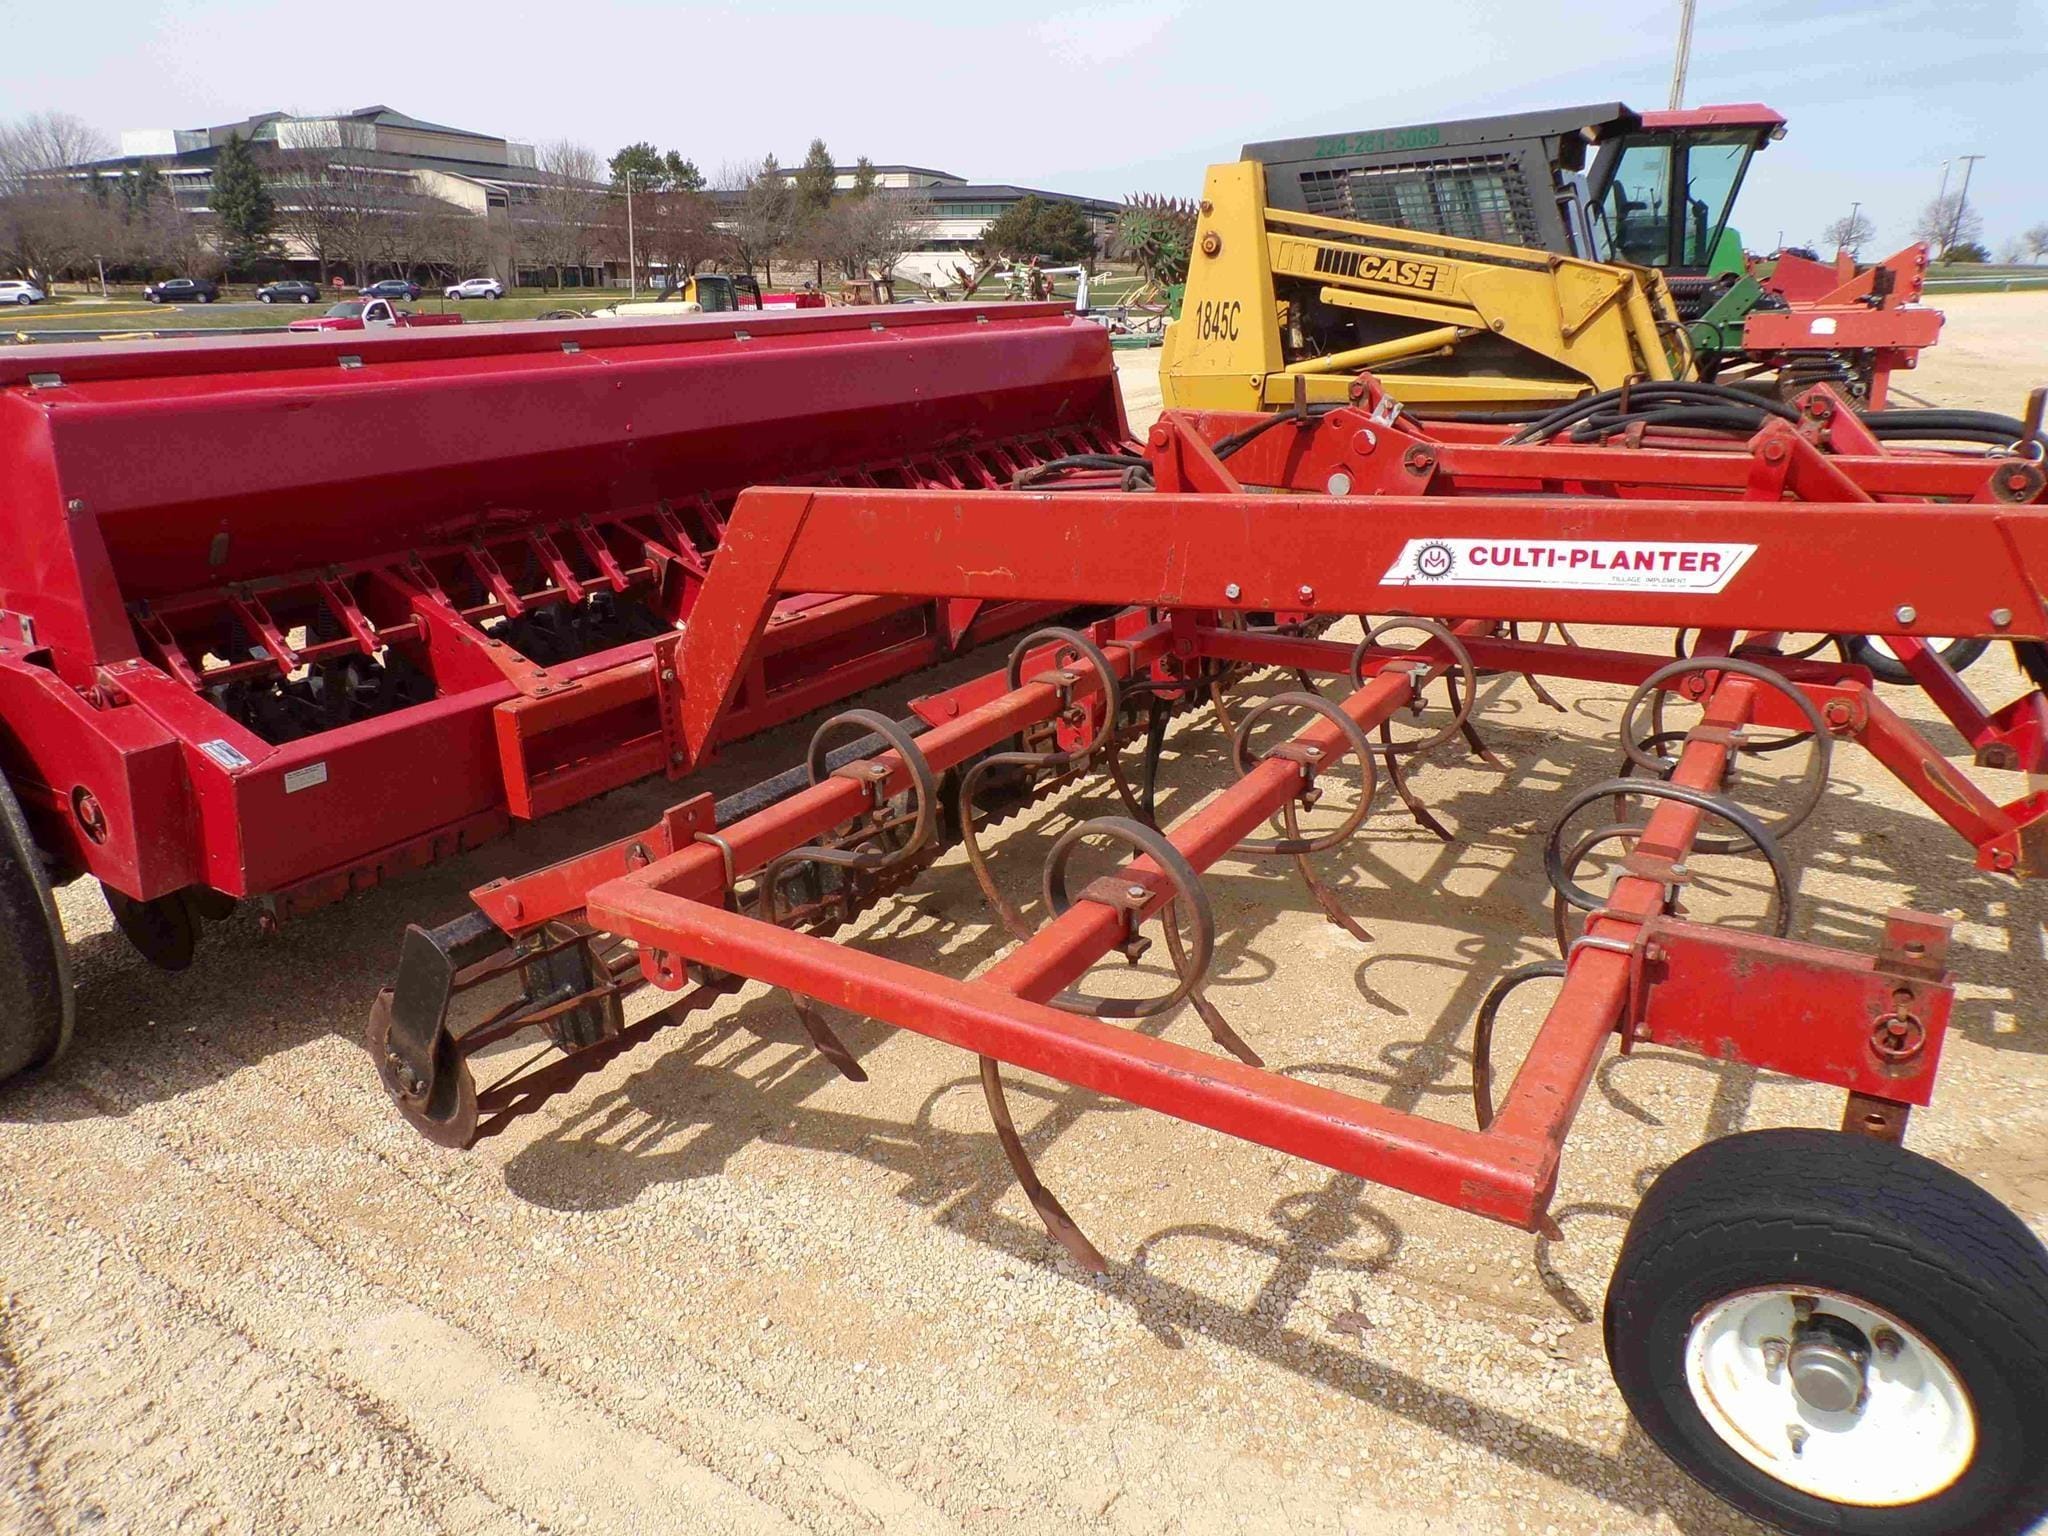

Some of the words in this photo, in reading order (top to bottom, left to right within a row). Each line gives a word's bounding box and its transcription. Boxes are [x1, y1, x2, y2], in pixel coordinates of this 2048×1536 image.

[1358, 256, 1437, 288] CASE
[1196, 300, 1240, 342] 1845C
[1468, 545, 1721, 572] CULTI-PLANTER
[1612, 575, 1641, 583] TILLAGE
[1645, 576, 1687, 584] IMPLEMENT
